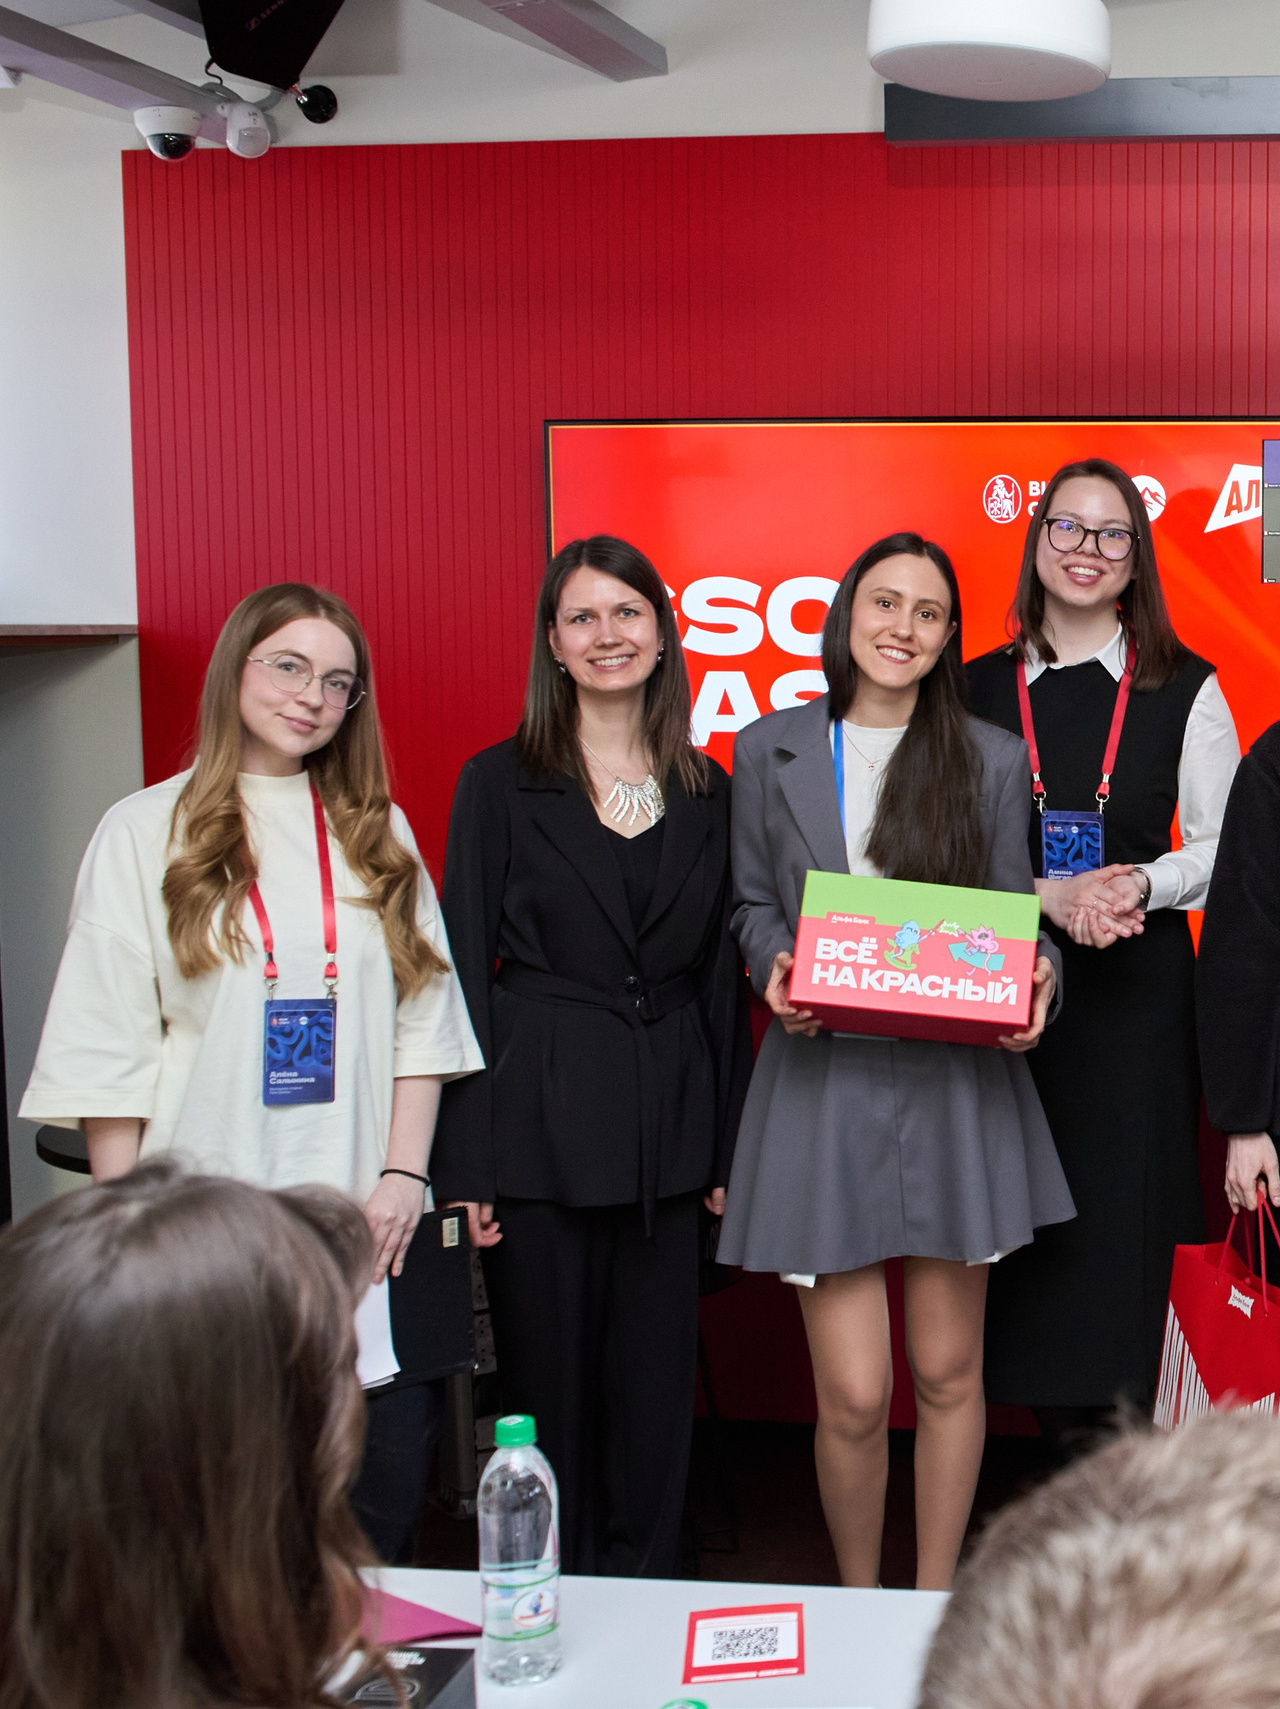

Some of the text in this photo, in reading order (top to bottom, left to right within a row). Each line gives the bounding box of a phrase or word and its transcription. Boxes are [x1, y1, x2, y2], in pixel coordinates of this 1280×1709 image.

[664, 576, 841, 657] SO
[815, 936, 878, 965] ВСЁ
[811, 963, 1018, 1006] НА КРАСНЫЙ
